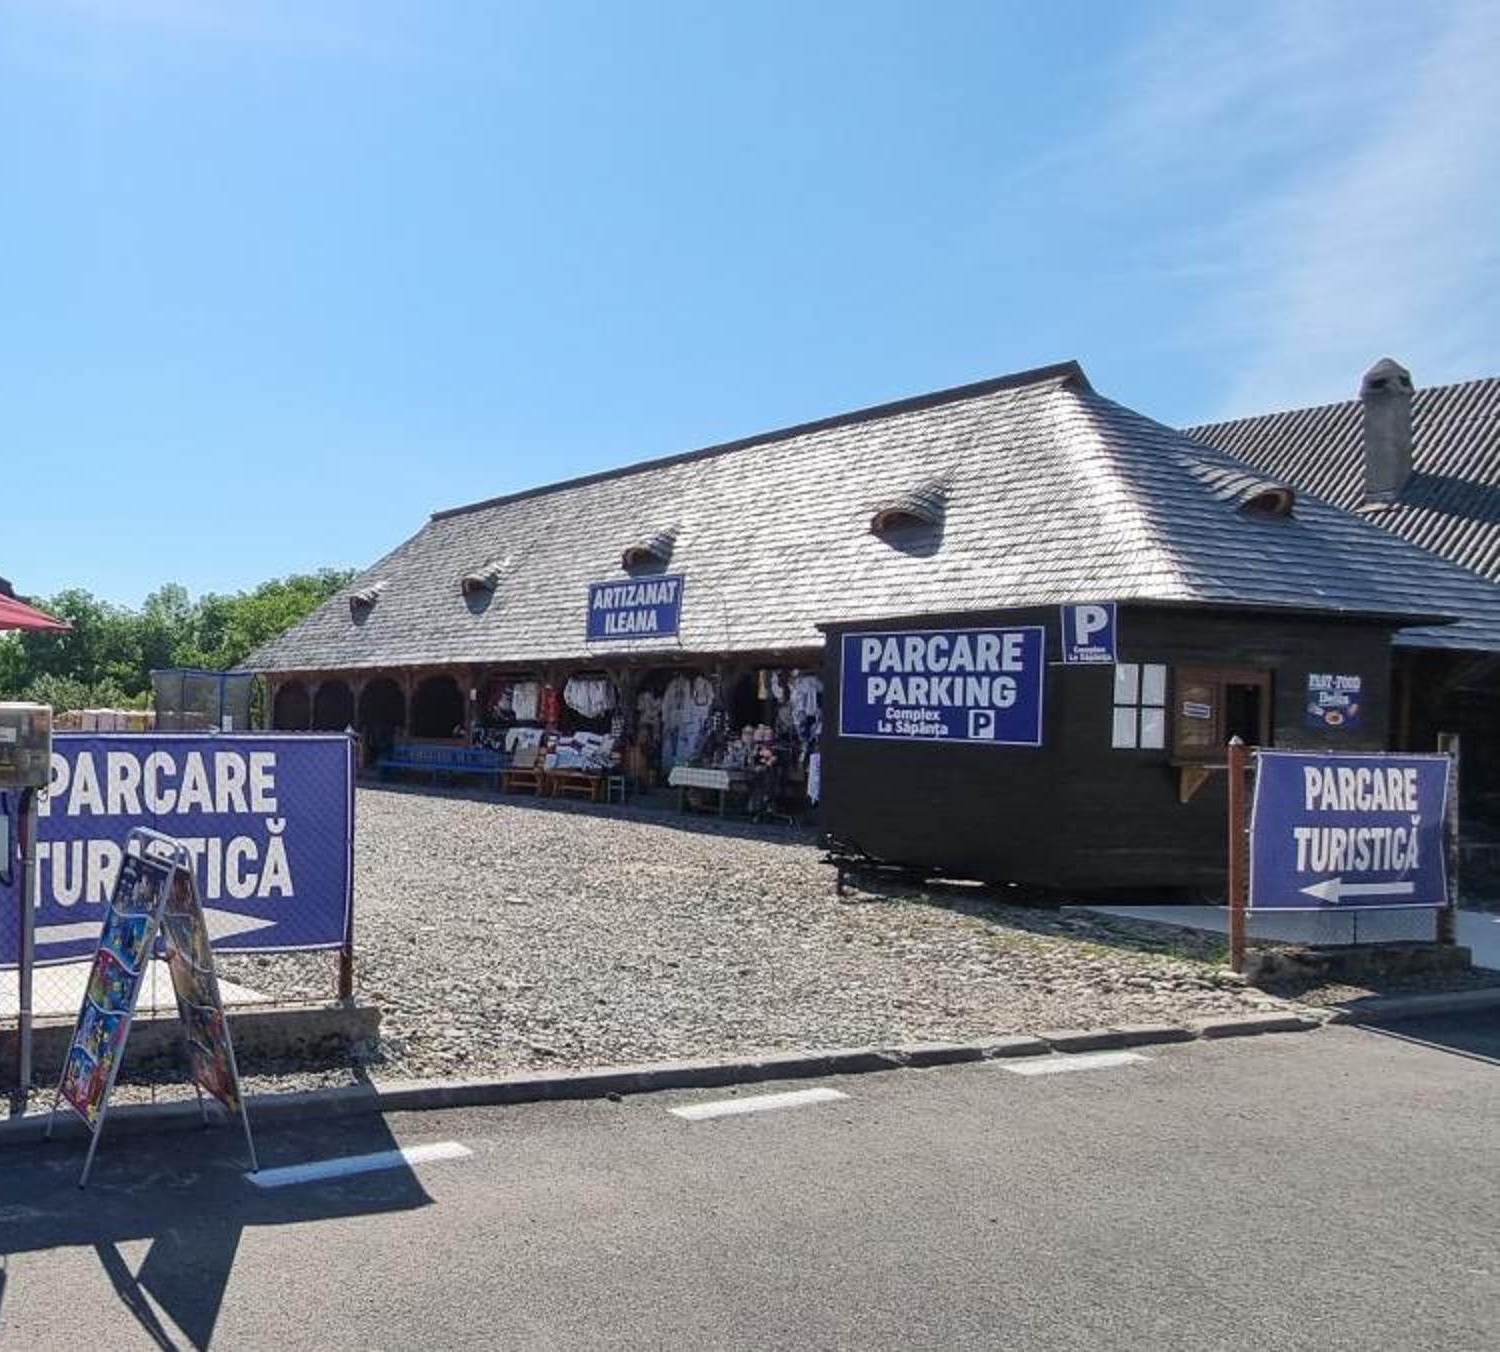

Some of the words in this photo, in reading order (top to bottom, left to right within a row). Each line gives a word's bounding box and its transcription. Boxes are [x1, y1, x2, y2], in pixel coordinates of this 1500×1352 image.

[592, 580, 678, 610] ARTIZANAT
[605, 609, 658, 634] ILEANA
[1075, 605, 1109, 645] P
[861, 633, 1025, 673] PARCARE
[867, 676, 1017, 708] PARKING
[877, 720, 893, 734] La
[885, 706, 941, 722] Complex
[37, 752, 278, 817] PARCARE
[1303, 766, 1418, 811] PARCARE
[16, 817, 294, 908] TURTICĂ
[1293, 814, 1421, 872] TURISTICĂ
